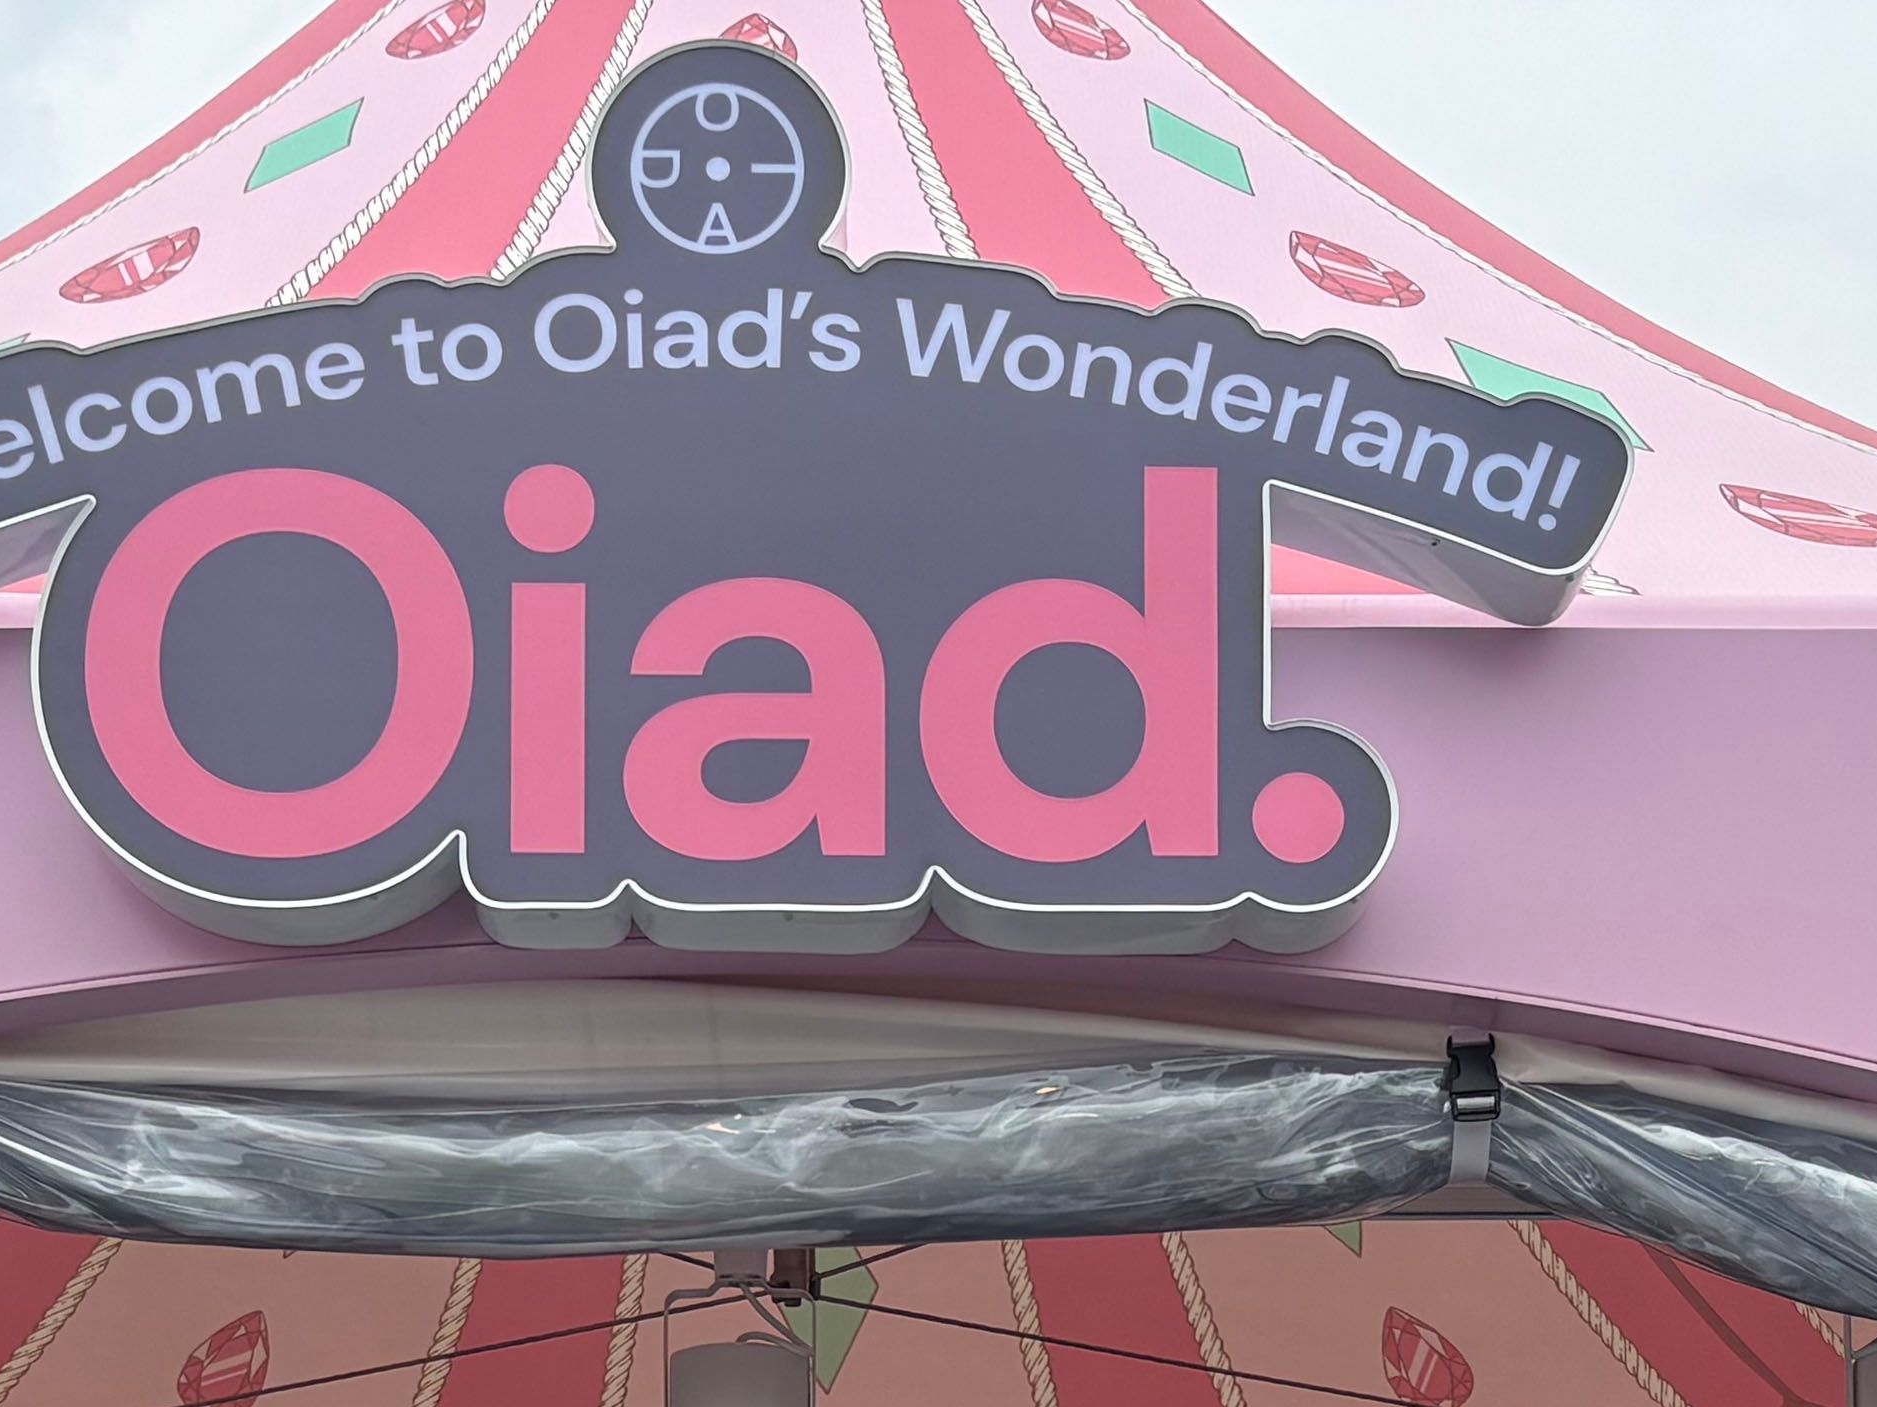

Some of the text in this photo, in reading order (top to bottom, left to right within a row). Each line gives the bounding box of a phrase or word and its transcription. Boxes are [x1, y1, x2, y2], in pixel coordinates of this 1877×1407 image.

[393, 305, 502, 391] to
[529, 286, 865, 378] Oiad's
[901, 302, 1583, 534] Wonderland!
[83, 462, 1346, 866] Oiad.
